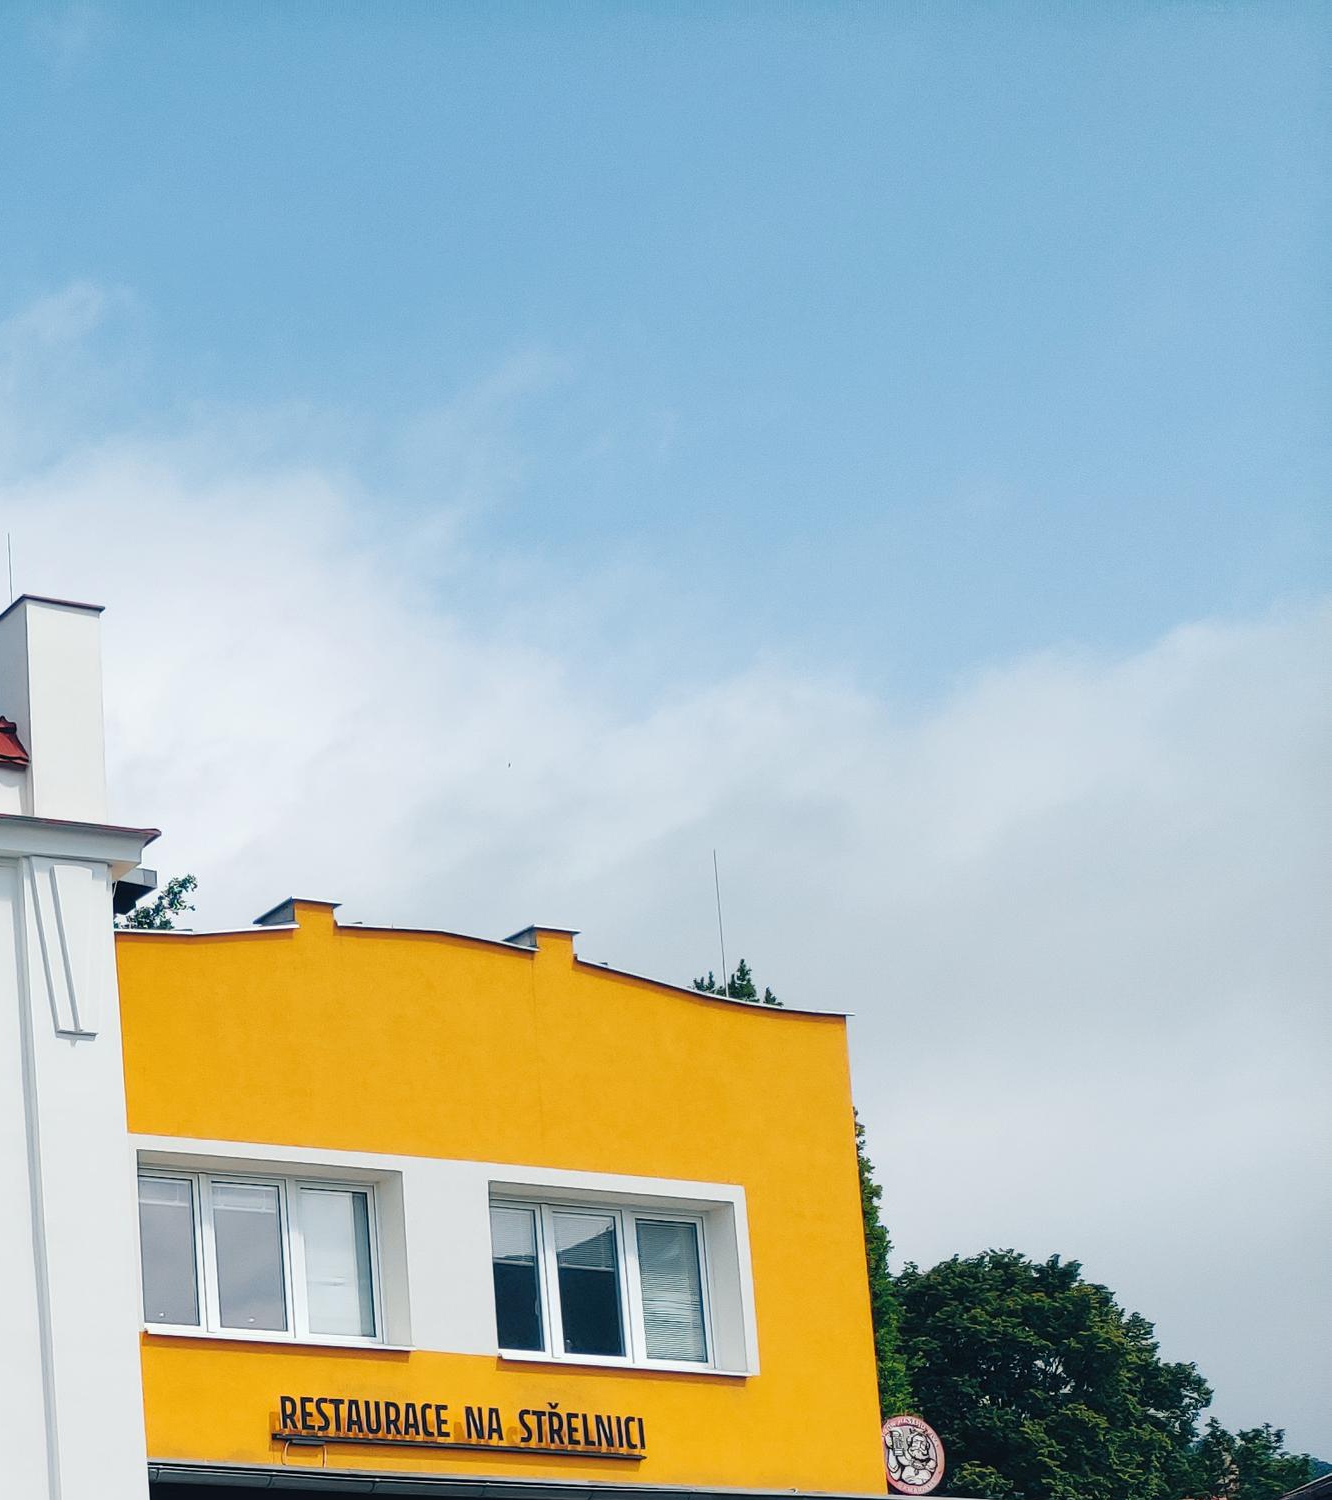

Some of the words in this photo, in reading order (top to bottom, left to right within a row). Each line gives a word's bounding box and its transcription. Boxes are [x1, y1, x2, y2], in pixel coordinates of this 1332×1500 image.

[280, 1395, 450, 1438] RESTAURACE
[465, 1406, 504, 1440] NA
[519, 1402, 645, 1450] STŘELNICI
